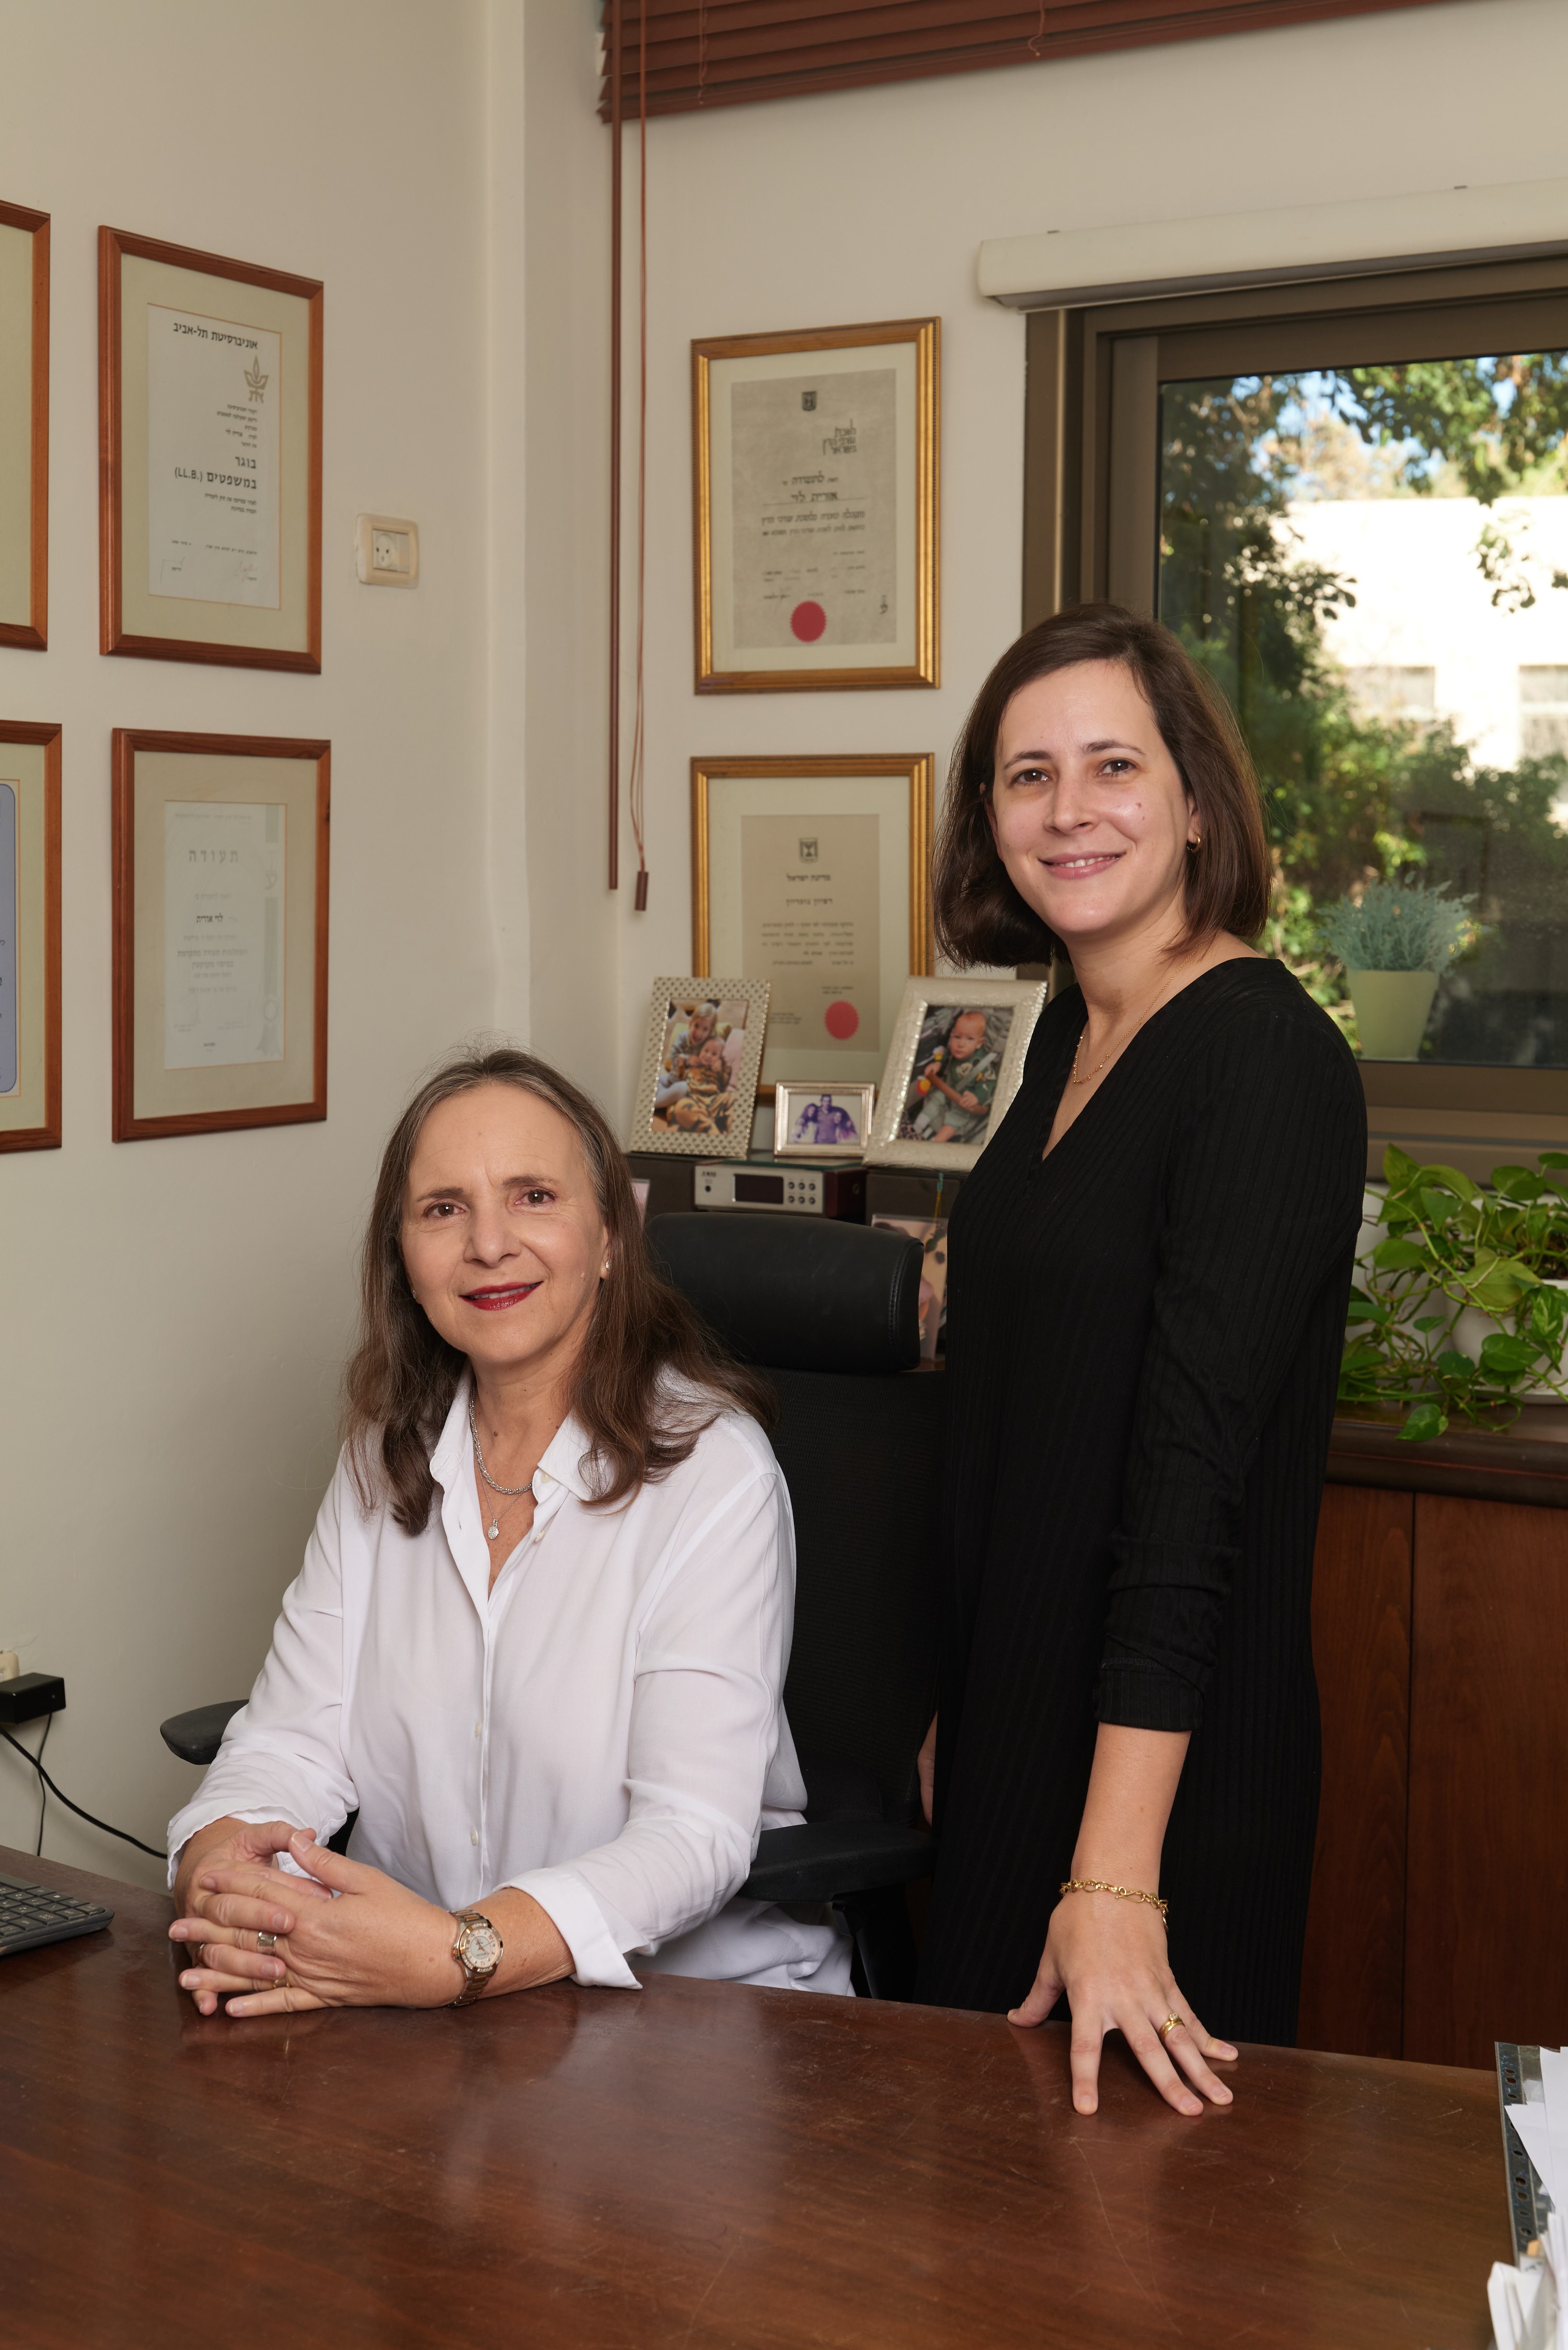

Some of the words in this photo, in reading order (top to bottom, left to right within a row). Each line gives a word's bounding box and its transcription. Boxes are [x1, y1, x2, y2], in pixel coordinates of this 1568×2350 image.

[174, 322, 208, 339] תל-אביב
[211, 331, 258, 349] אוניברסיטת
[235, 456, 256, 469] בוגר
[175, 466, 203, 482] (LL.B.)
[206, 472, 257, 489] במשפטים
[189, 849, 238, 863] תעודה
